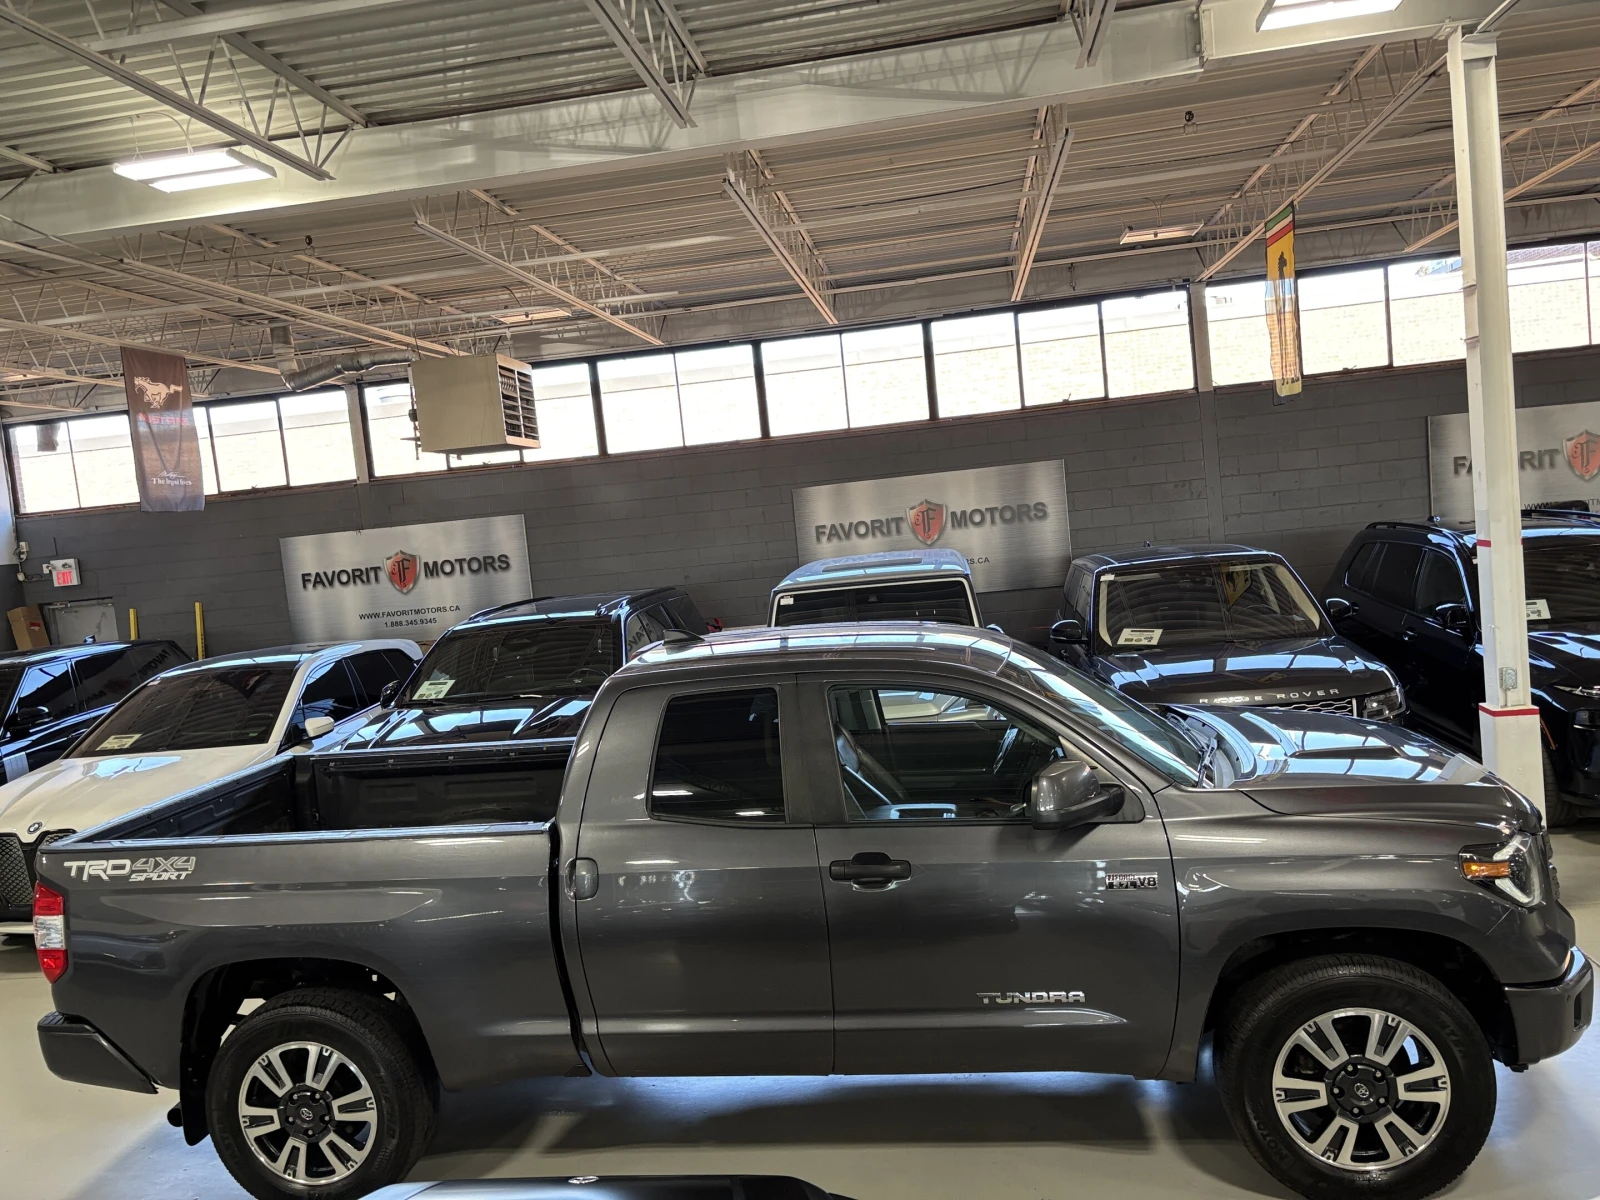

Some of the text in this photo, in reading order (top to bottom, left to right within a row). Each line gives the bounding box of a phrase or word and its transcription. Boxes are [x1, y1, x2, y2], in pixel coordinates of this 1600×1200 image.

[1453, 448, 1559, 476] FRIT
[814, 516, 903, 543] FAVORIT
[950, 501, 1048, 529] MOTORS
[56, 570, 73, 586] EXIT
[301, 565, 382, 590] FAVORIT
[423, 553, 511, 579] MOTORS
[358, 605, 461, 620] WWW.FAVORITMOTORS.CA
[384, 617, 437, 628] 1.888.345.9345
[1276, 688, 1340, 700] ROVER
[63, 859, 132, 882] TRD
[129, 871, 192, 882] SPORT
[1138, 876, 1157, 887] V8
[976, 991, 1086, 1004] TUNDRA
